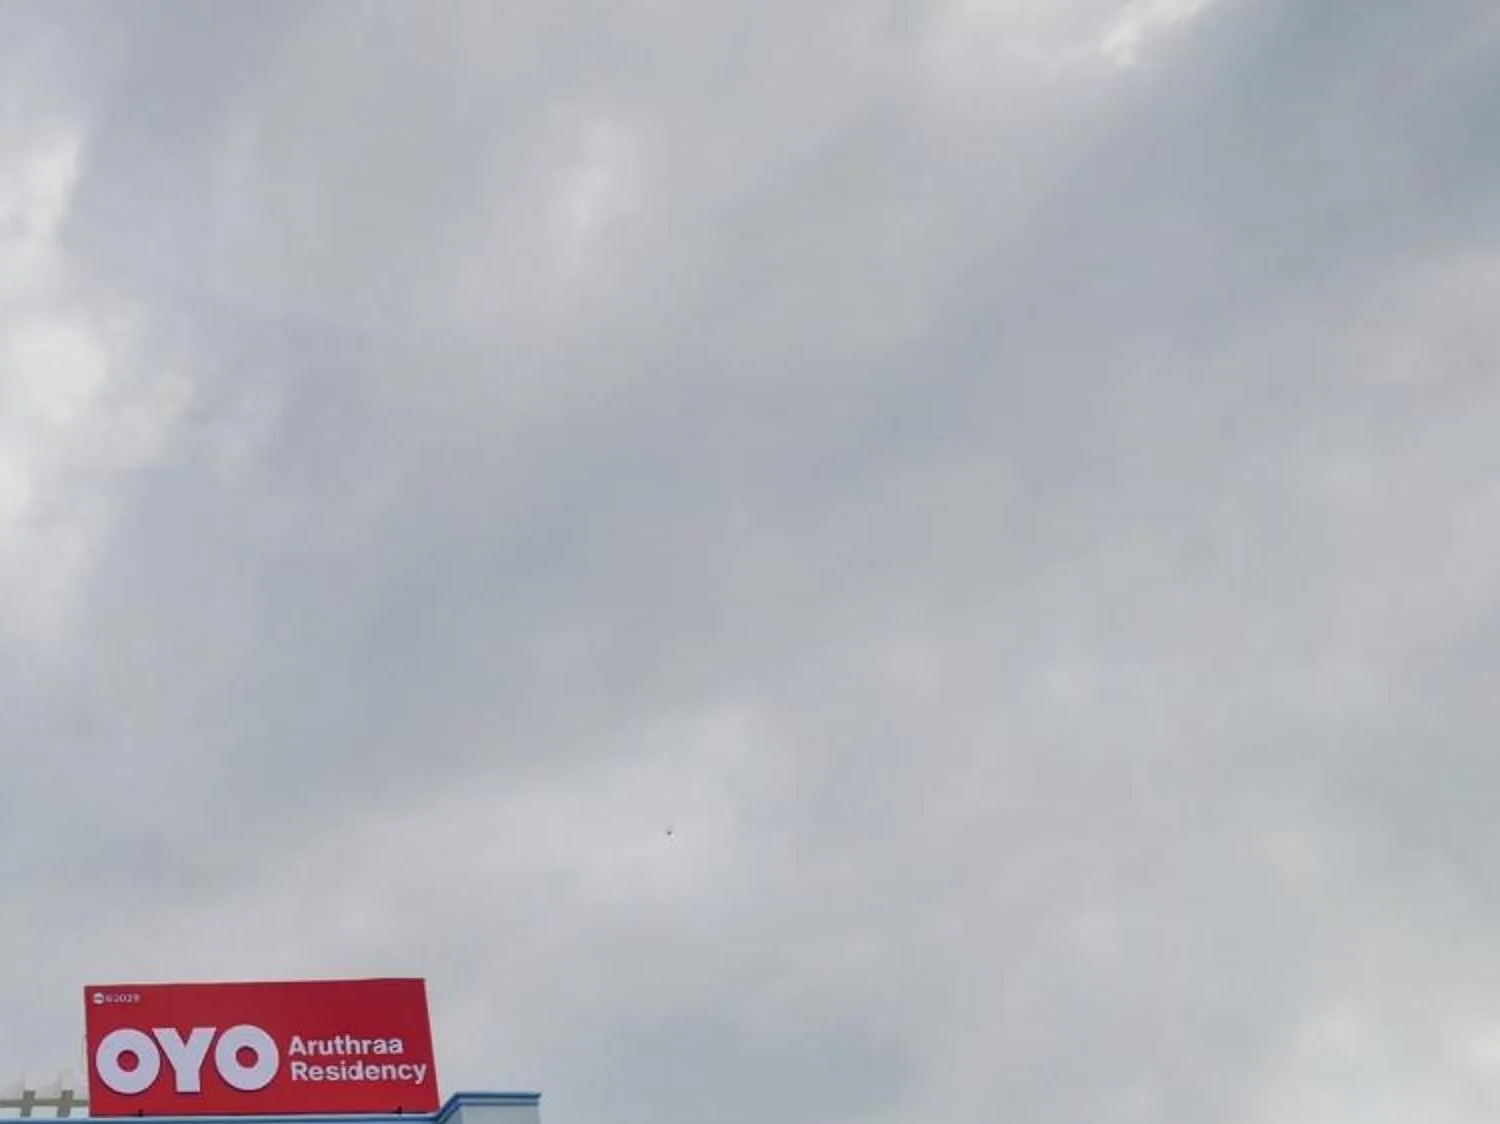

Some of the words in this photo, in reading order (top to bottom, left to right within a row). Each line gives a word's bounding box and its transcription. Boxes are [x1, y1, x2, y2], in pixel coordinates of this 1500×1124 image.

[288, 1035, 404, 1056] Aruthraa
[95, 1024, 280, 1094] OYO
[290, 1060, 427, 1084] Residency
